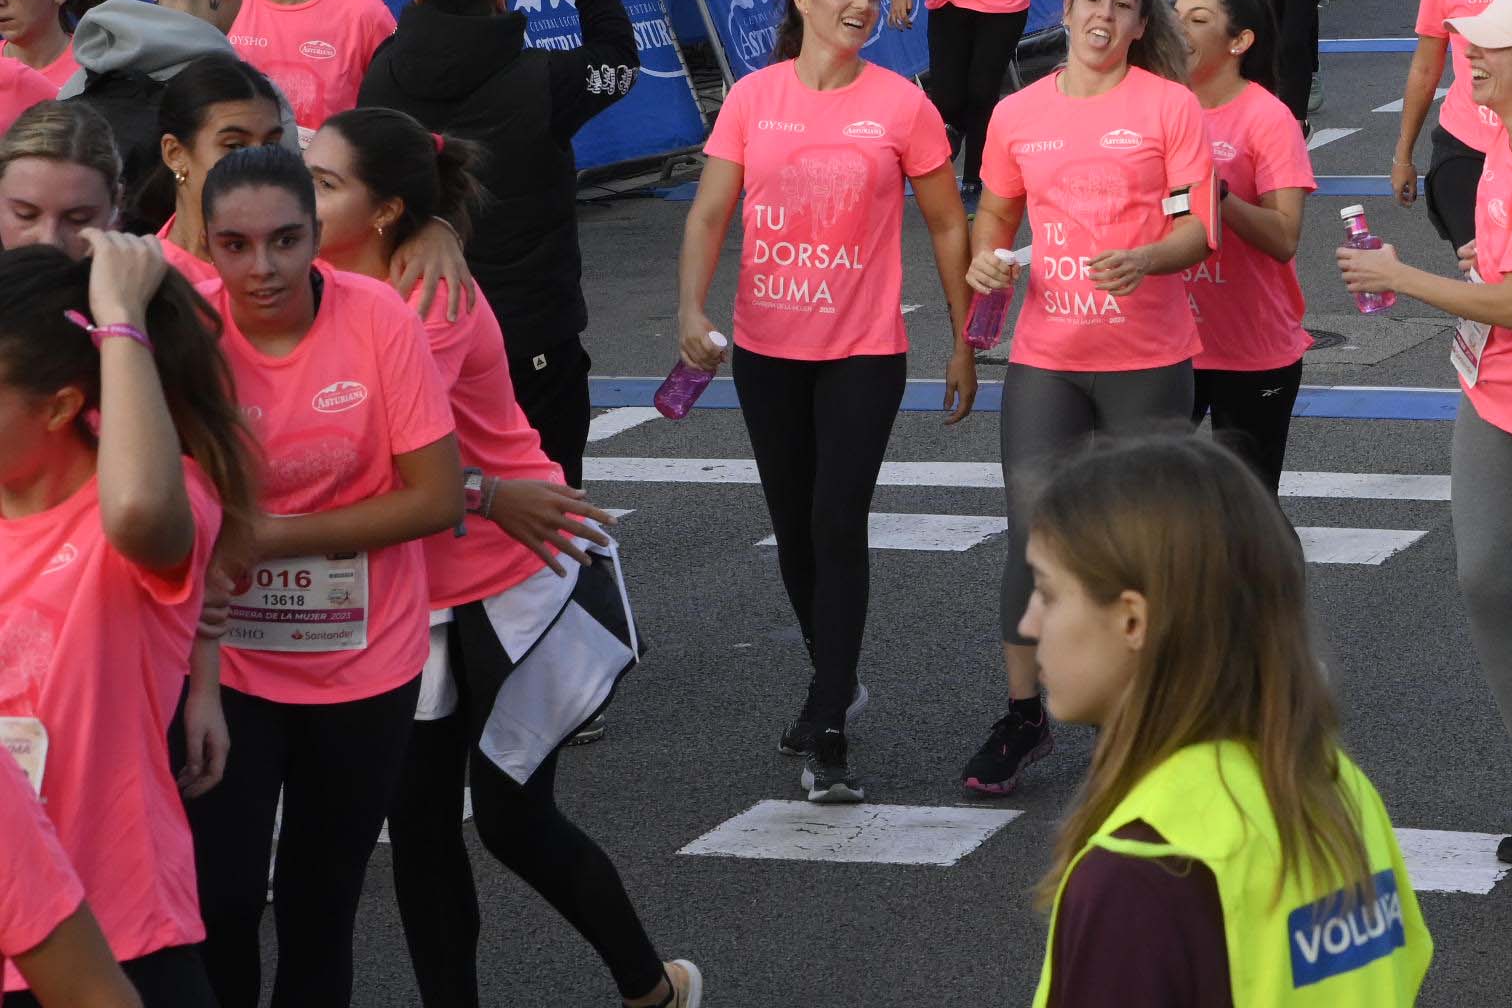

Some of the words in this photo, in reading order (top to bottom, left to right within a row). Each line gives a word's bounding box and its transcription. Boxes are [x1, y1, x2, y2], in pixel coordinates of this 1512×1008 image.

[229, 36, 268, 47] OYSHO
[758, 120, 805, 133] OYSHO
[1479, 105, 1498, 127] SU
[755, 205, 784, 231] TU
[1043, 222, 1067, 246] TU
[753, 240, 863, 270] DORSAL
[1043, 256, 1091, 281] DOR
[1183, 266, 1226, 283] SAL
[753, 274, 833, 304] SUMA
[1044, 291, 1121, 315] SUMA
[317, 389, 366, 410] ASTURIANA
[257, 569, 311, 589] 016
[263, 594, 304, 606] 13618
[230, 609, 263, 619] ARRERA
[265, 610, 279, 619] DE
[281, 610, 292, 619] LA
[295, 612, 327, 620] MUJER
[331, 611, 351, 620] 2023
[305, 629, 353, 641] Santander
